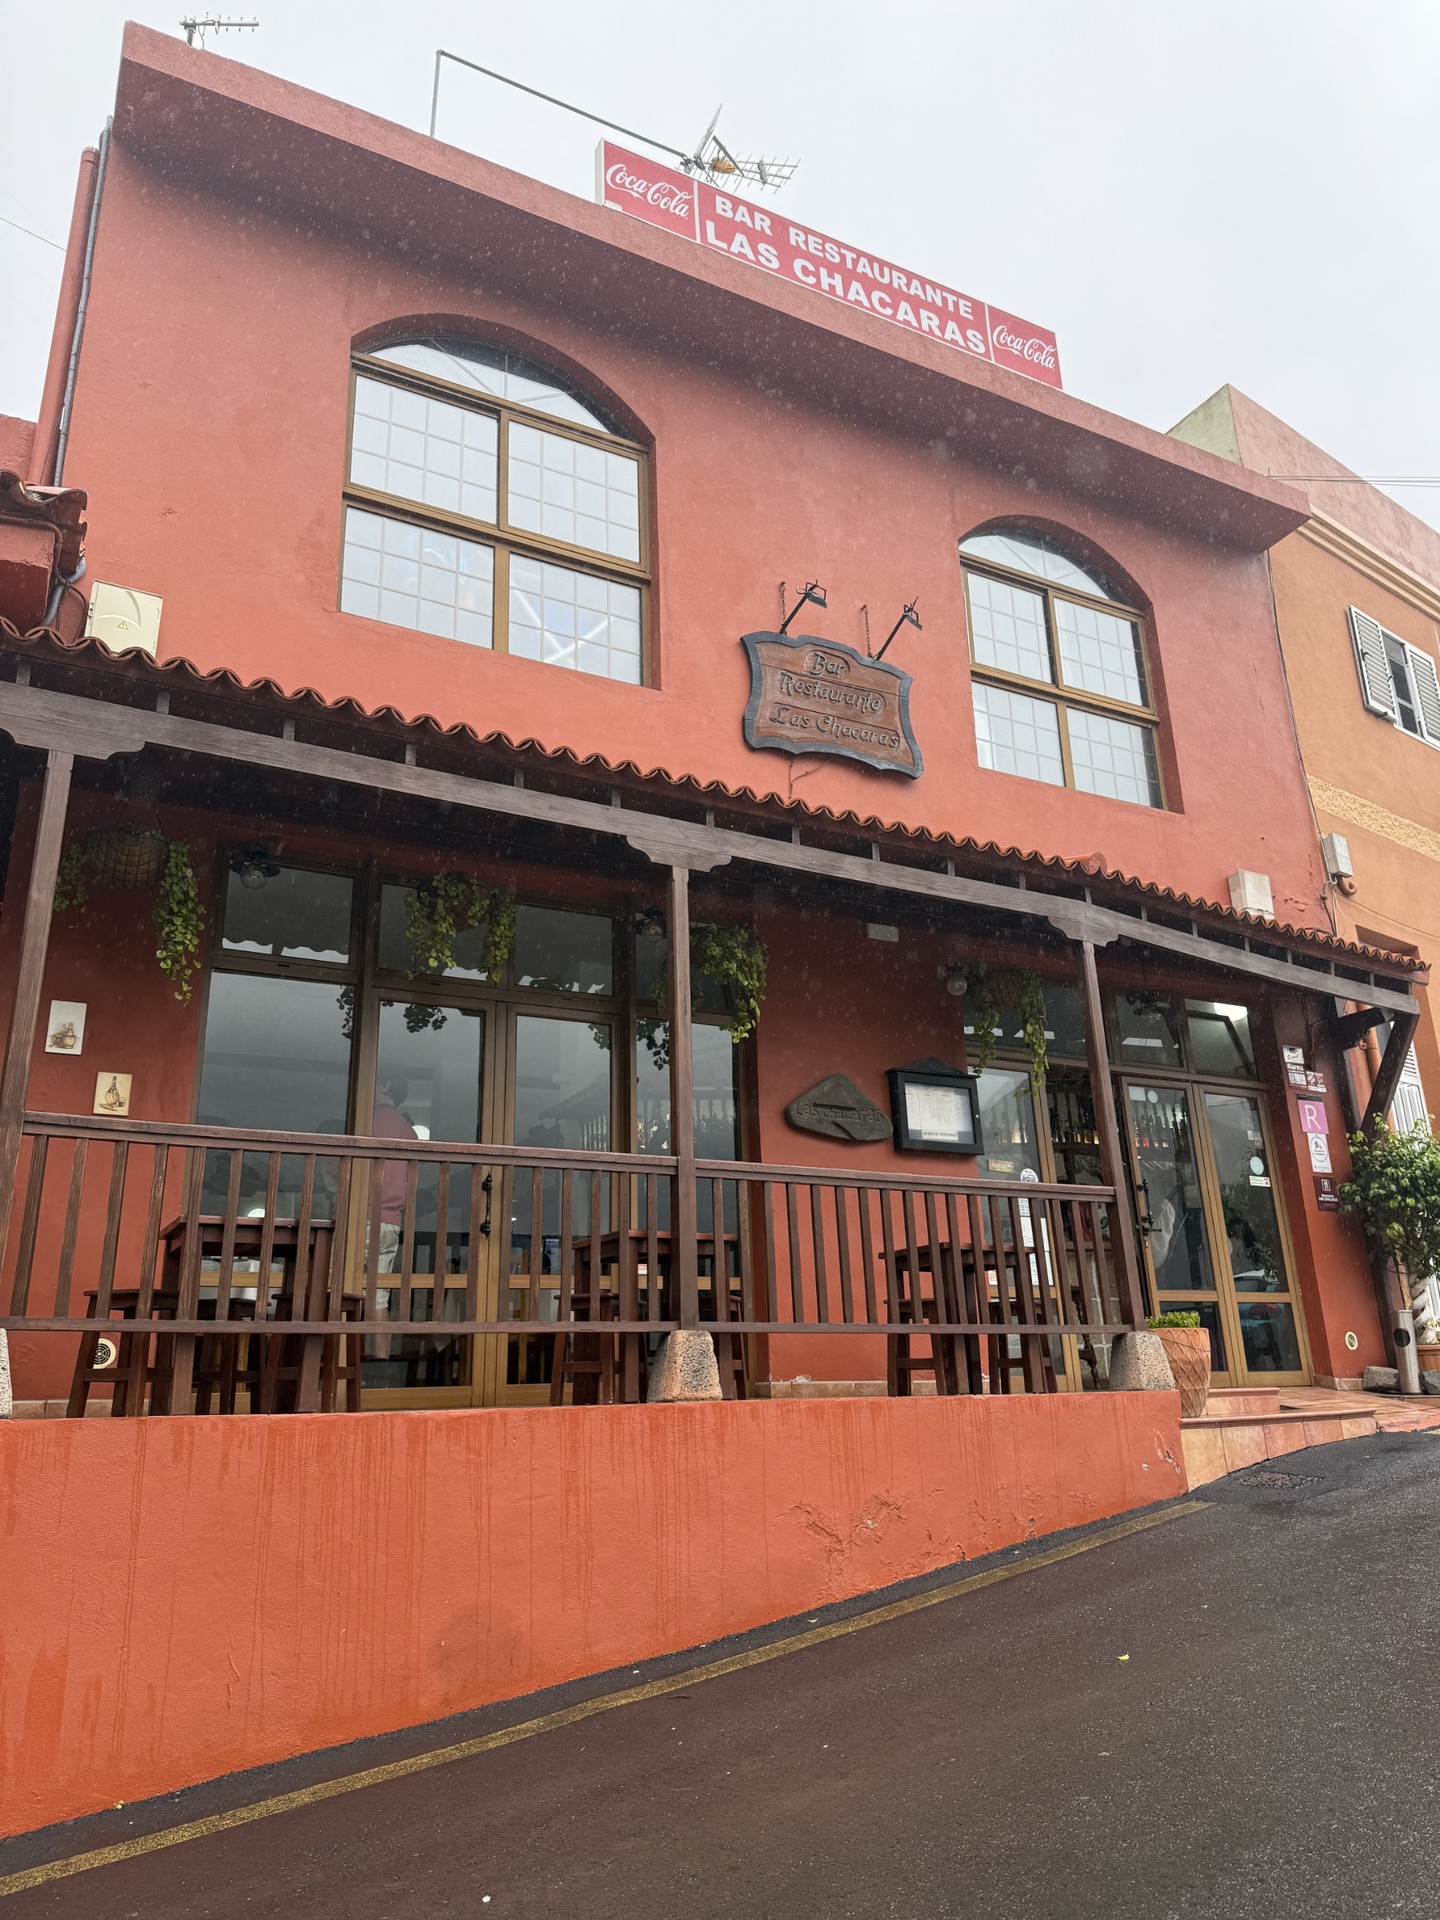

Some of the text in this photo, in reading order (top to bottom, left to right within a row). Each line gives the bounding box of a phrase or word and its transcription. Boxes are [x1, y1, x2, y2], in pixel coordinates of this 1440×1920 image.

[606, 164, 693, 217] Coca-Cola
[715, 194, 974, 320] BAR RESTAURANTE
[705, 219, 986, 354] LAS CHACARAS
[993, 325, 1057, 369] Coca-Cola
[810, 652, 844, 676] Bar
[780, 671, 883, 714] Restaurante
[769, 707, 899, 748] Las Chacaras
[1304, 1104, 1322, 1130] R
